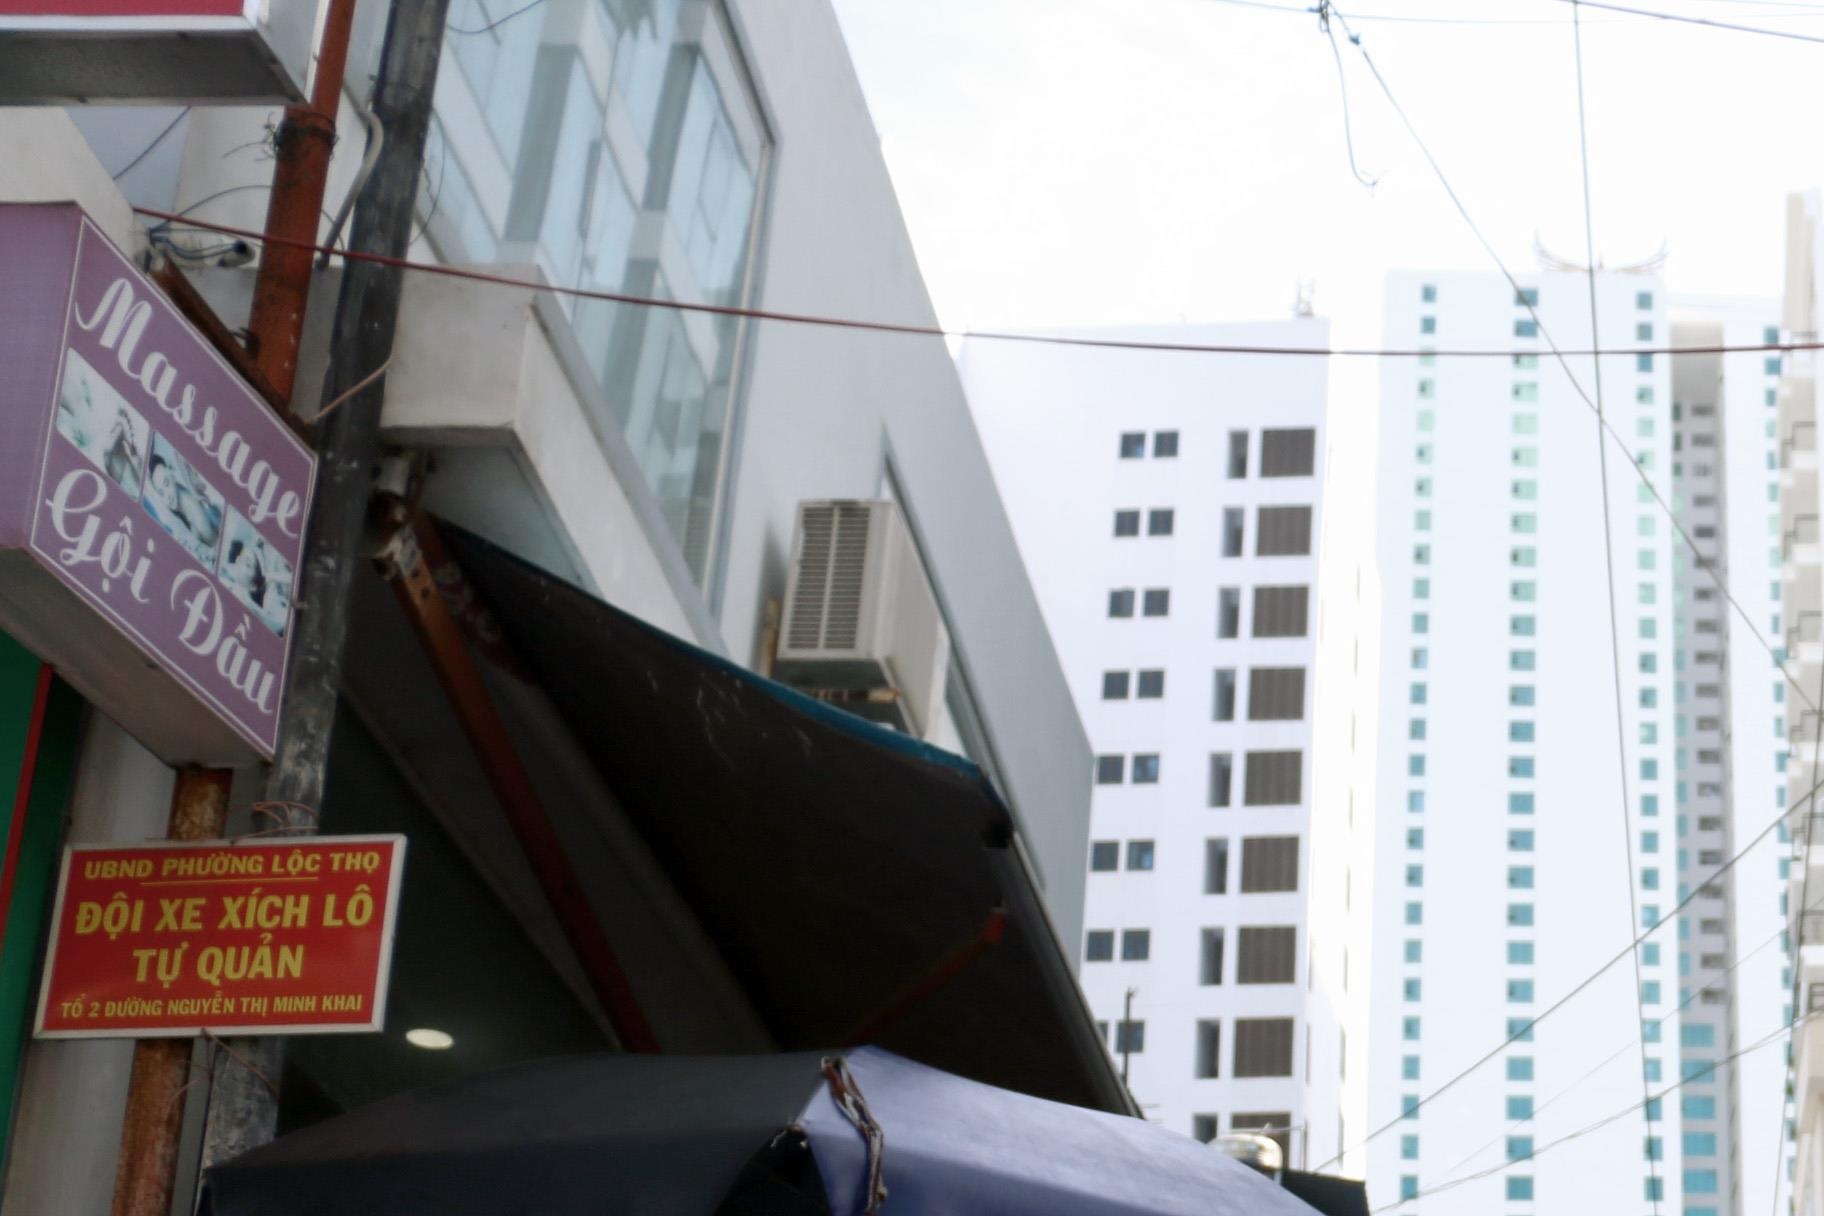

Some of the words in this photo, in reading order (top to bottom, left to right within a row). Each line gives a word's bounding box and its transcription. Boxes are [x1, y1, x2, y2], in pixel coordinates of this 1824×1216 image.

[74, 277, 300, 538] Massage
[45, 468, 154, 602] Gội
[170, 569, 275, 715] Đầu
[84, 859, 154, 880] UBND
[162, 851, 264, 877] PHƯỜNG
[271, 849, 321, 876] LỘC
[75, 891, 144, 940] ĐỘI
[154, 897, 206, 932] XE
[218, 888, 310, 930] XÍCH
[323, 884, 375, 928] LÔ
[132, 941, 190, 989] TỰ
[197, 933, 304, 987] QUẢN
[61, 993, 87, 1018] TỔ
[88, 1001, 102, 1018] 2
[105, 995, 163, 1018] ĐƯỜNG
[167, 990, 235, 1016] NGUYỄN
[240, 997, 269, 1016] THỊ
[273, 995, 317, 1013] MINH
[322, 994, 364, 1012] KHAI
